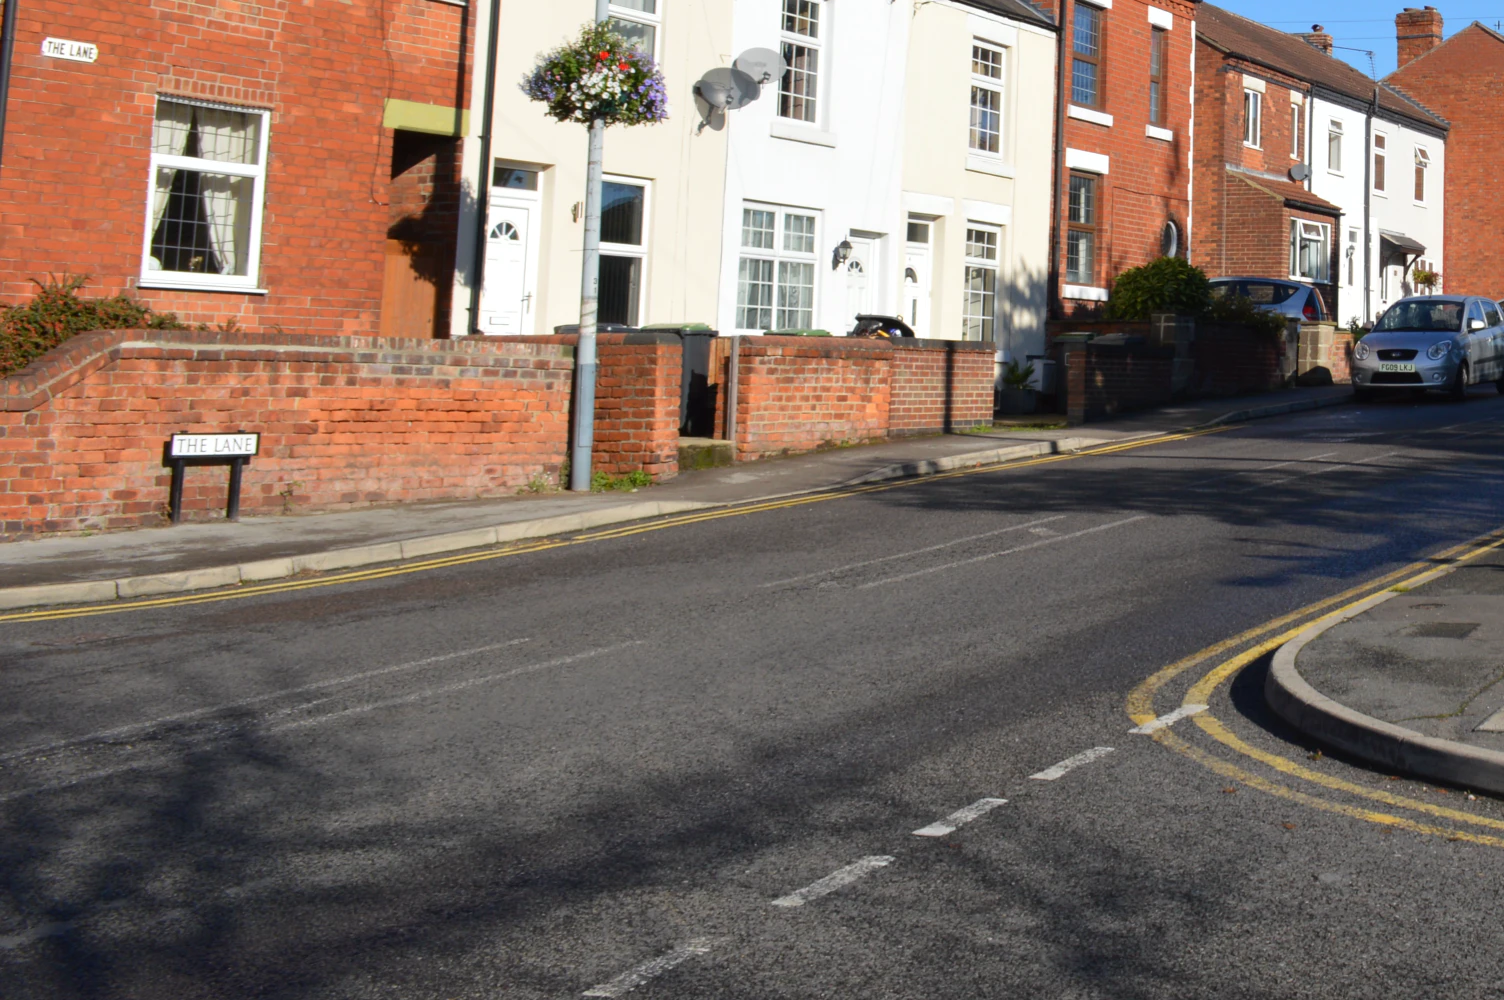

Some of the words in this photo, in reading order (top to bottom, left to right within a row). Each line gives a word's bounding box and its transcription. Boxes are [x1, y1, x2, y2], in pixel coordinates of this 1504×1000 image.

[48, 41, 66, 55] THE
[69, 44, 95, 60] LANE
[1381, 363, 1399, 371] FG09
[1399, 363, 1413, 371] LKJ
[178, 438, 208, 453] THE
[214, 437, 252, 453] LANE
